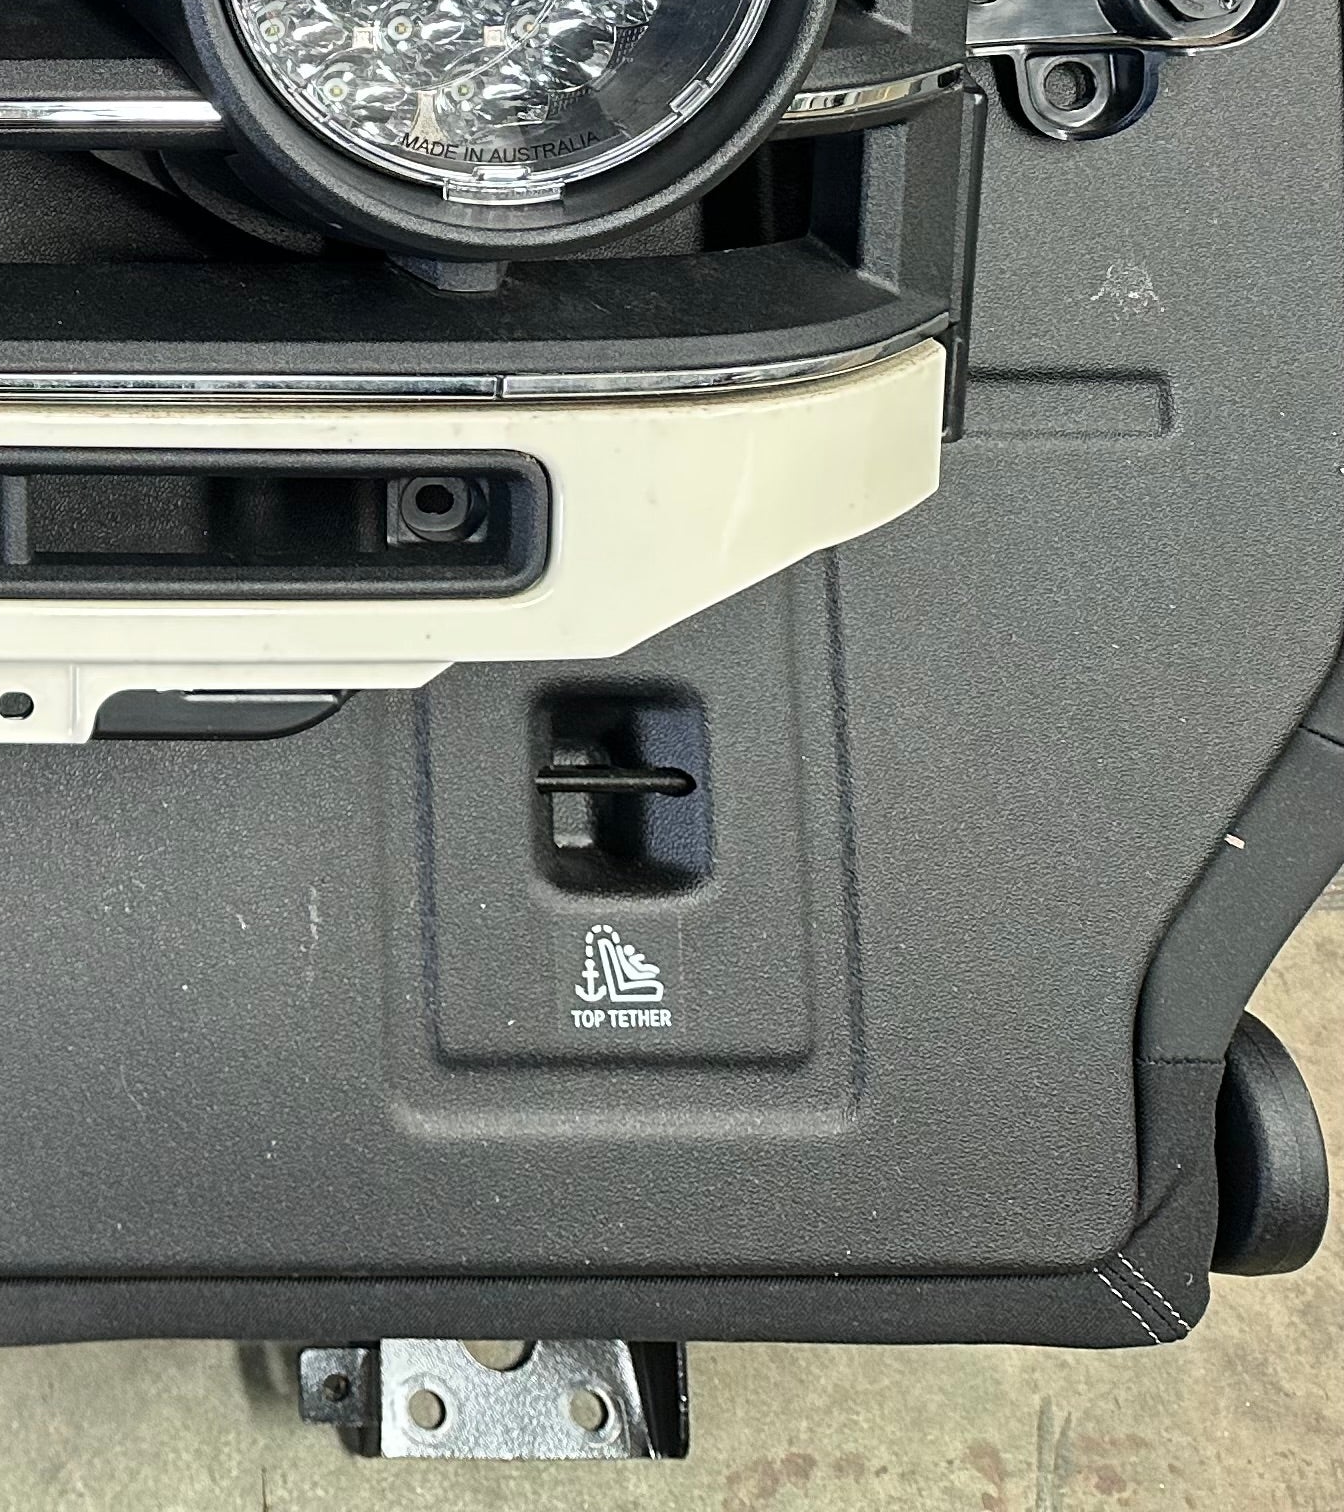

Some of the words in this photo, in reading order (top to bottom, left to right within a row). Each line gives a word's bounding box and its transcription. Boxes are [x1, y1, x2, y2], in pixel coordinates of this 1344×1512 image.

[400, 132, 459, 160] MADE
[464, 146, 484, 163] IN
[489, 130, 601, 164] AUSTRALIA
[570, 1009, 606, 1028] TOP
[607, 1009, 672, 1028] TETHER
